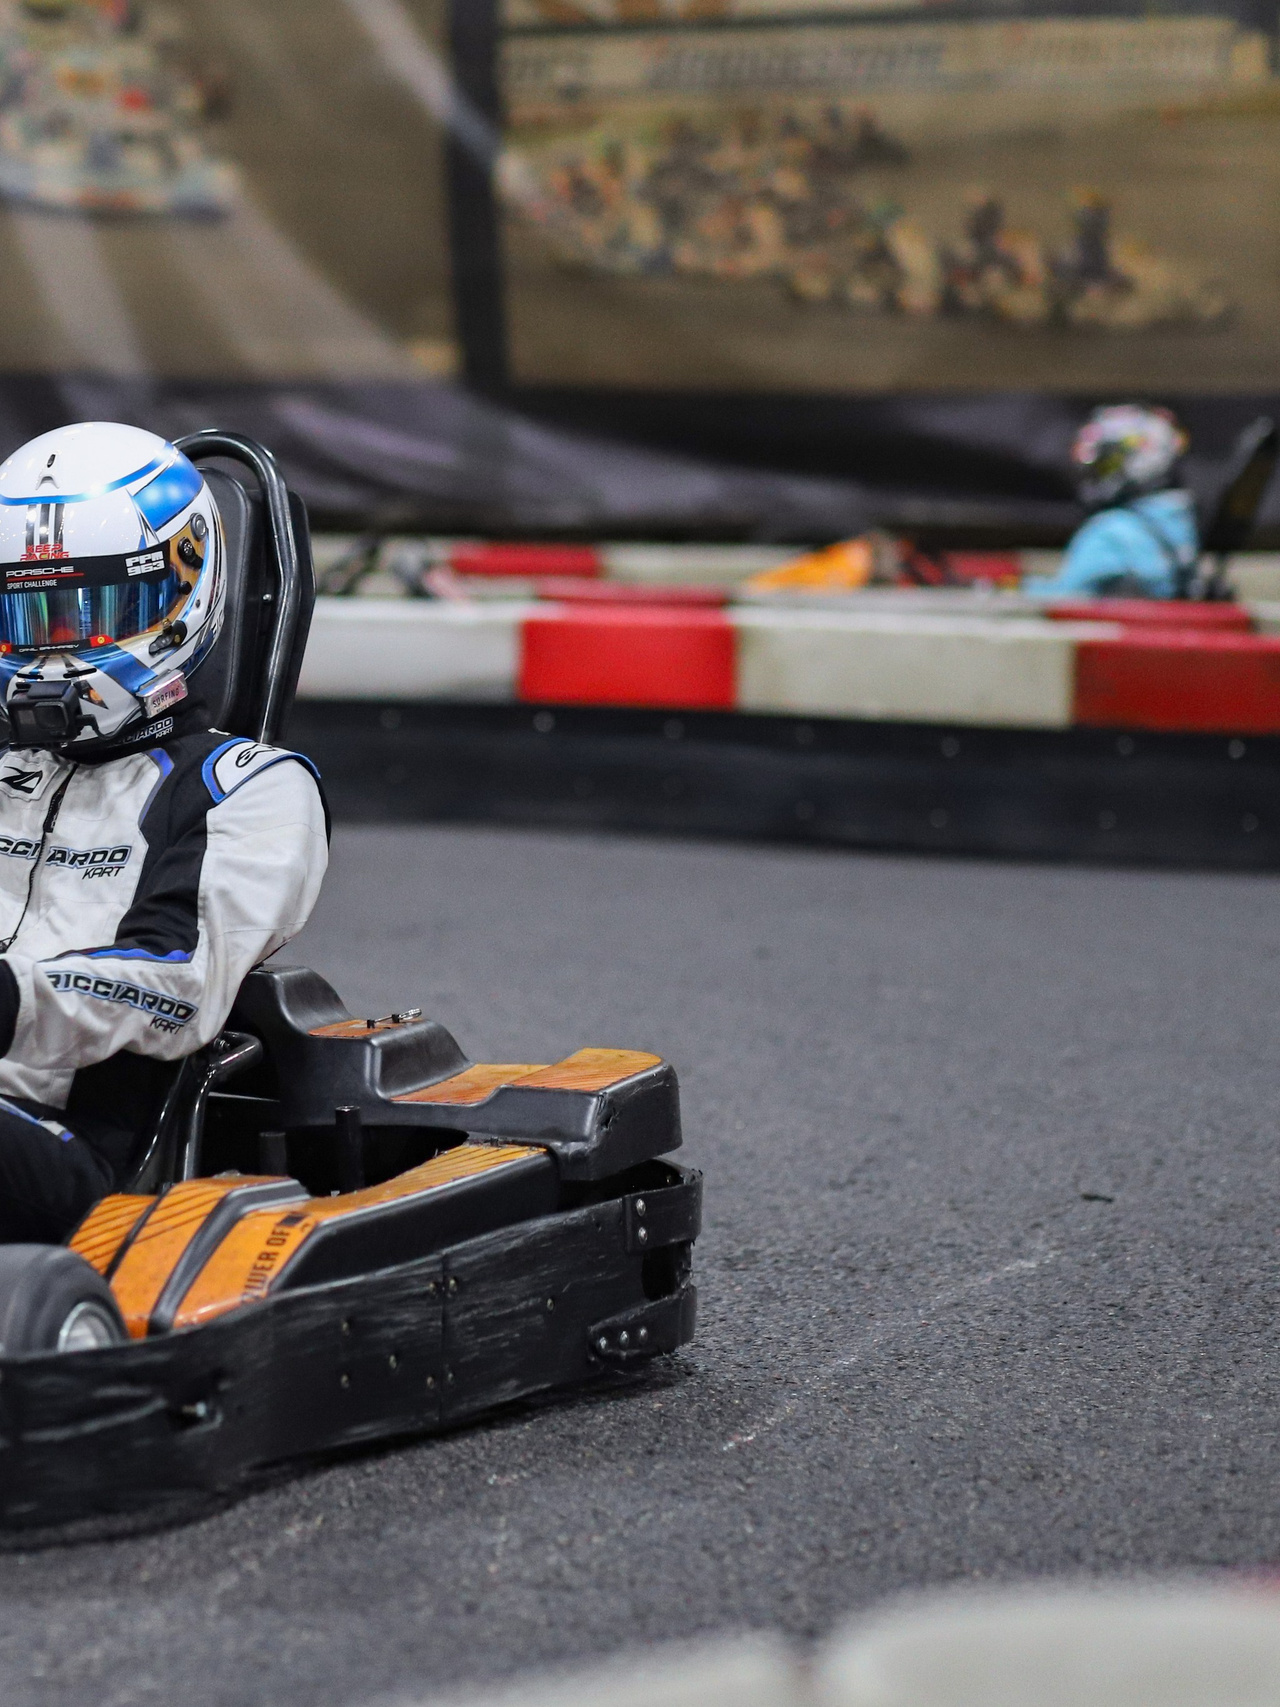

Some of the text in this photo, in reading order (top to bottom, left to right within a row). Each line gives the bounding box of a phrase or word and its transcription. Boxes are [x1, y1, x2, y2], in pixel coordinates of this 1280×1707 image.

[20, 551, 70, 562] RACING
[26, 543, 62, 554] KEEP
[125, 550, 164, 568] PPM
[5, 565, 75, 578] PORSCHE
[126, 559, 166, 577] 963
[6, 579, 58, 590] SPORT CHALLENGE
[81, 865, 126, 880] KART
[46, 972, 196, 1022] RICCIARDO
[149, 1014, 185, 1035] KART
[266, 1227, 290, 1246] OF
